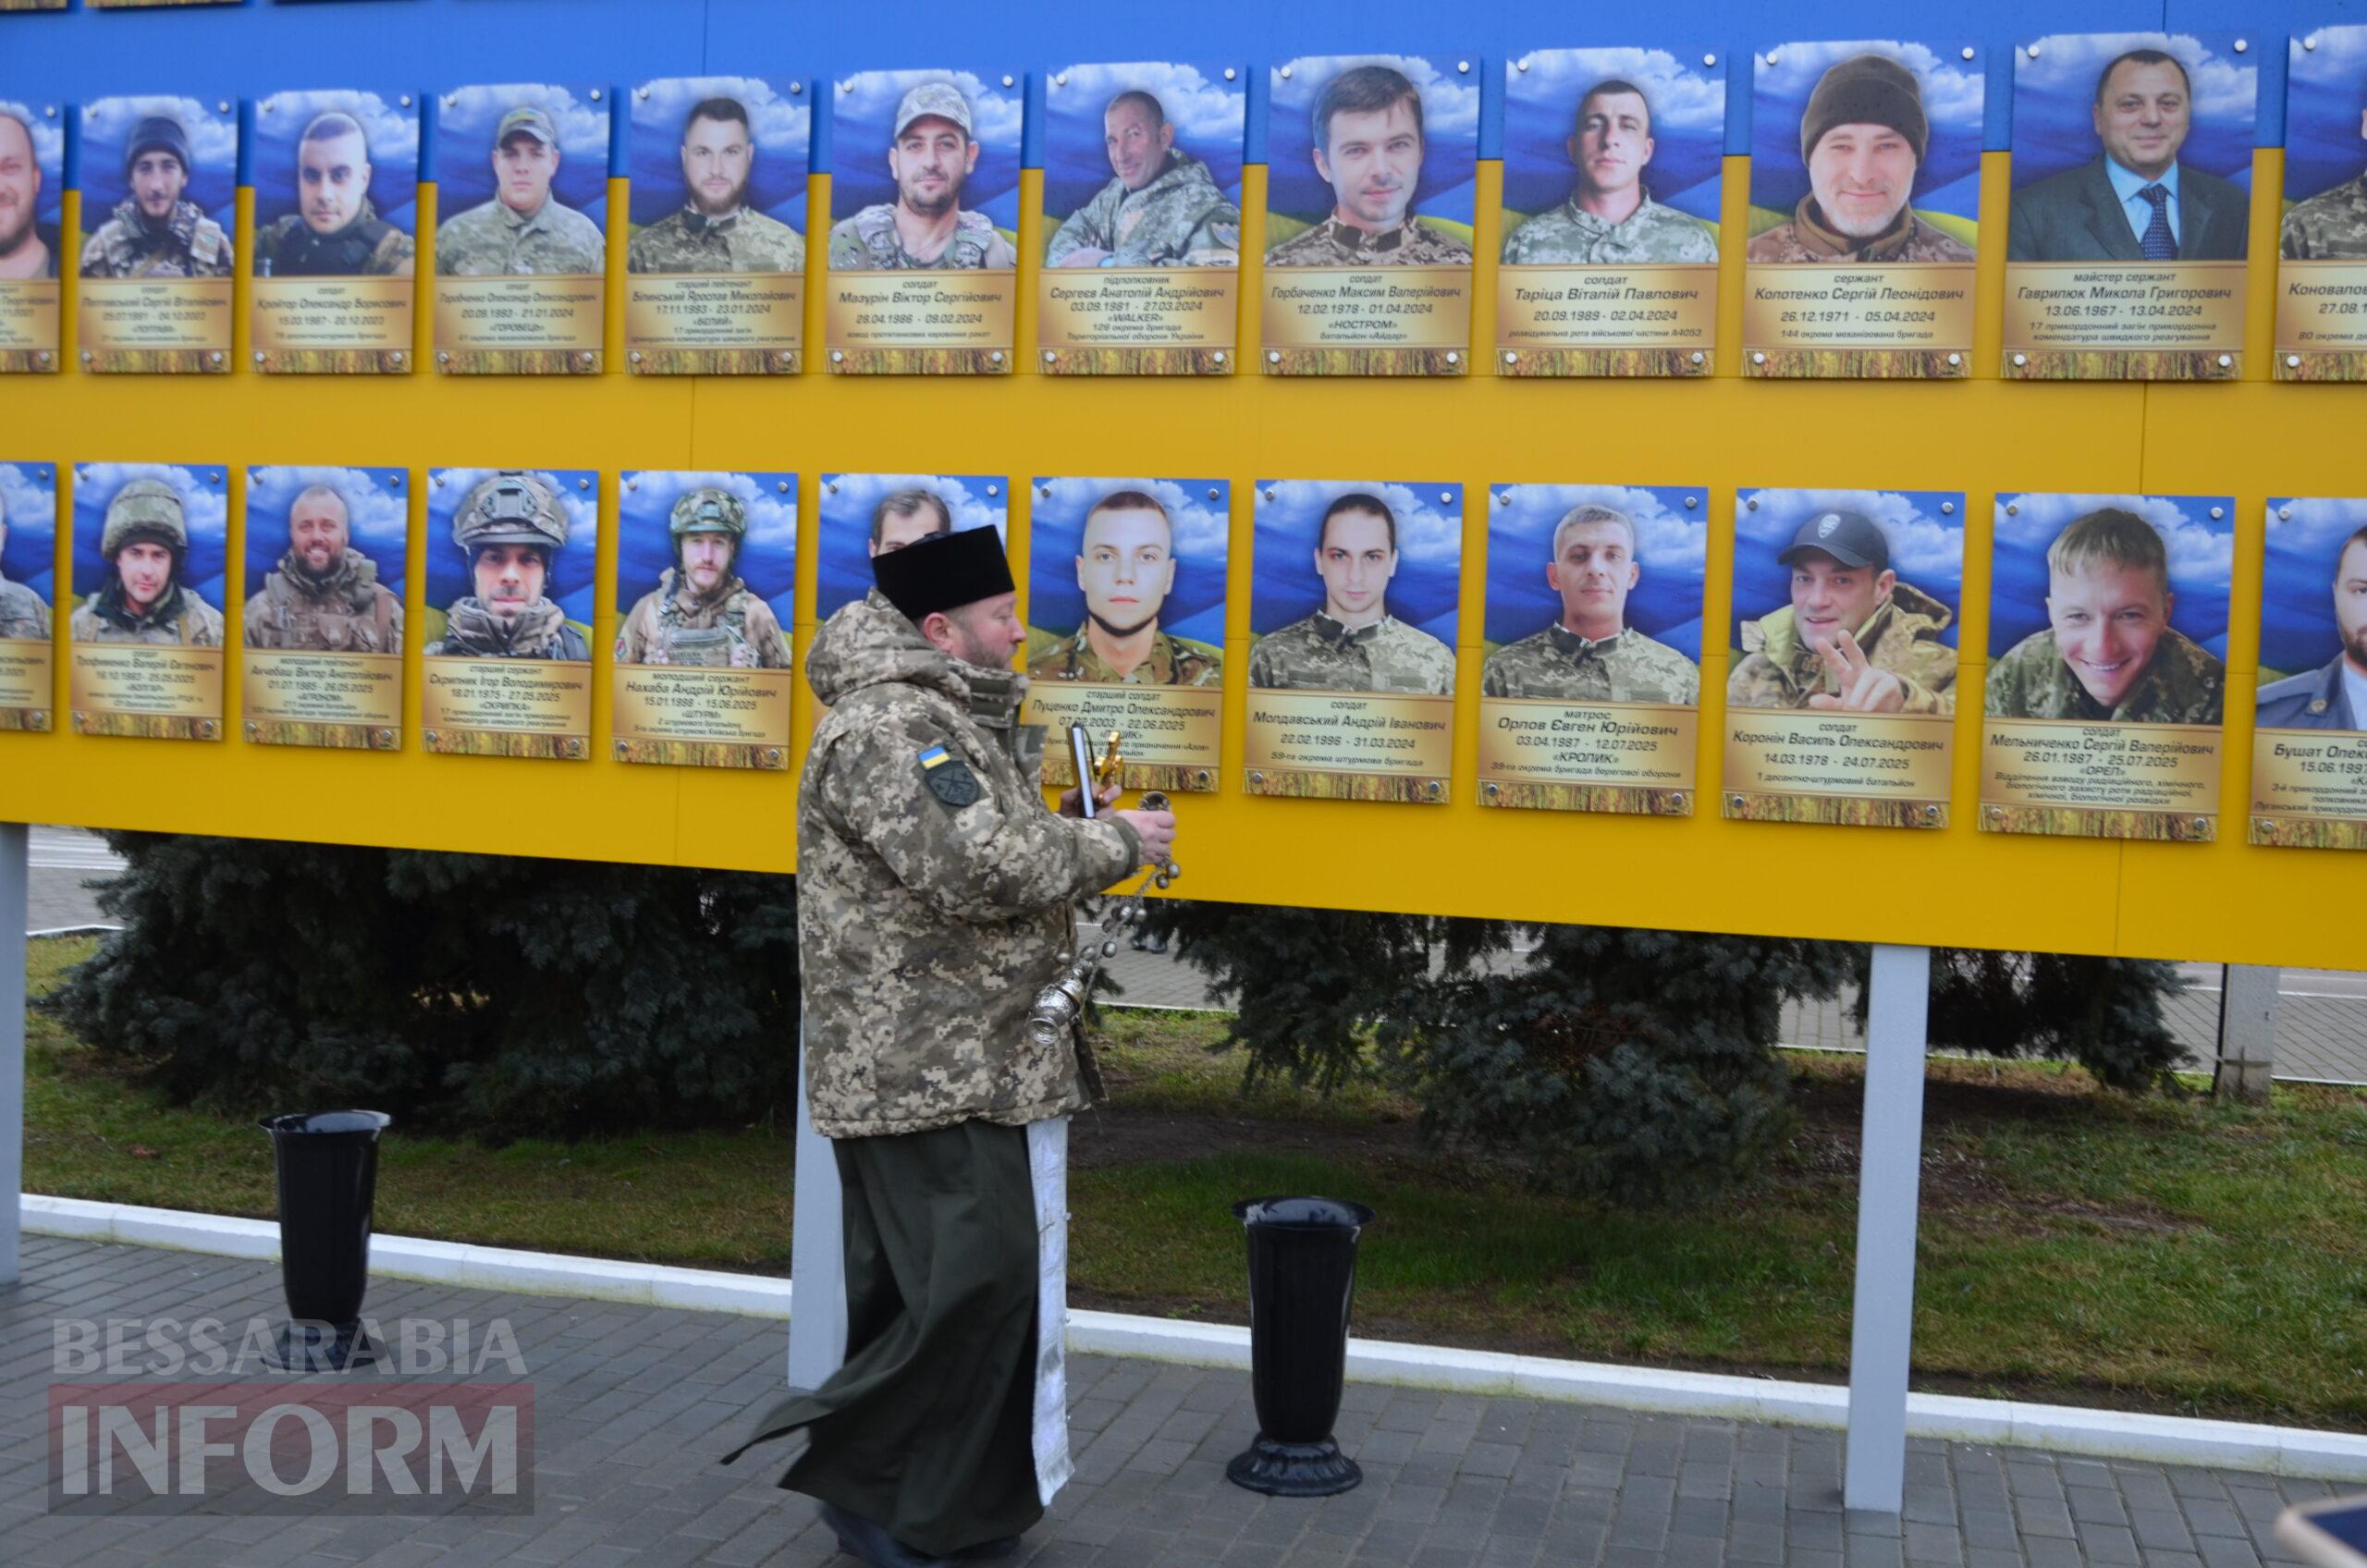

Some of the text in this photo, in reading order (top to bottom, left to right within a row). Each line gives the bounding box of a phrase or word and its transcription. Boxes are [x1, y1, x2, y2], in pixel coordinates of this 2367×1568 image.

[1103, 276, 1170, 286] підполковник
[1349, 275, 1382, 284] солдат
[1584, 276, 1628, 286] солдат
[1834, 274, 1883, 283] сержант
[2073, 272, 2176, 283] майстер сержант
[902, 281, 938, 289] солдат
[839, 291, 1001, 305] Мазурін Віктор Сергійович
[1099, 288, 1152, 299] Анатолій
[1155, 287, 1224, 300] Андрійович
[1271, 286, 1461, 300] Горбаченко Максим Валерійович
[1515, 288, 1698, 302] Таріца Віталій Павлович
[1755, 288, 1963, 302] Колотенко Сергій Леонідович
[2017, 287, 2231, 302] Гаврилюк Микола Григорович
[1143, 301, 1203, 311] 27.03.2024
[1368, 304, 1433, 313] 01.04.2024
[2044, 305, 2202, 317] 13.06.1967 13.04.2024
[1109, 313, 1163, 322] «WALKER»
[1611, 311, 1677, 321] 02.04.2024
[1781, 312, 1935, 323] 26.12.1971 05.04.2024
[626, 682, 777, 698] Нахаба Андрій Юрійович
[1081, 702, 1124, 715] Дмитро
[1127, 704, 1215, 719] Олександрович
[1331, 702, 1368, 710] солдат
[1253, 712, 1445, 730] Молдавський Андрій Іванович
[1564, 710, 1612, 720] матрос
[1498, 717, 1679, 736] Орлов Євген Юрійович
[1819, 723, 1858, 732] солдат
[2083, 728, 2121, 737] солдат
[1733, 730, 1944, 753] Коронін Василь Олександрович
[1991, 734, 2214, 755] Мельниченко Сергій Валерійович
[2274, 743, 2322, 759] Бушат
[1843, 757, 1909, 769] 24.07.2025
[2107, 755, 2177, 767] 25.07.2025
